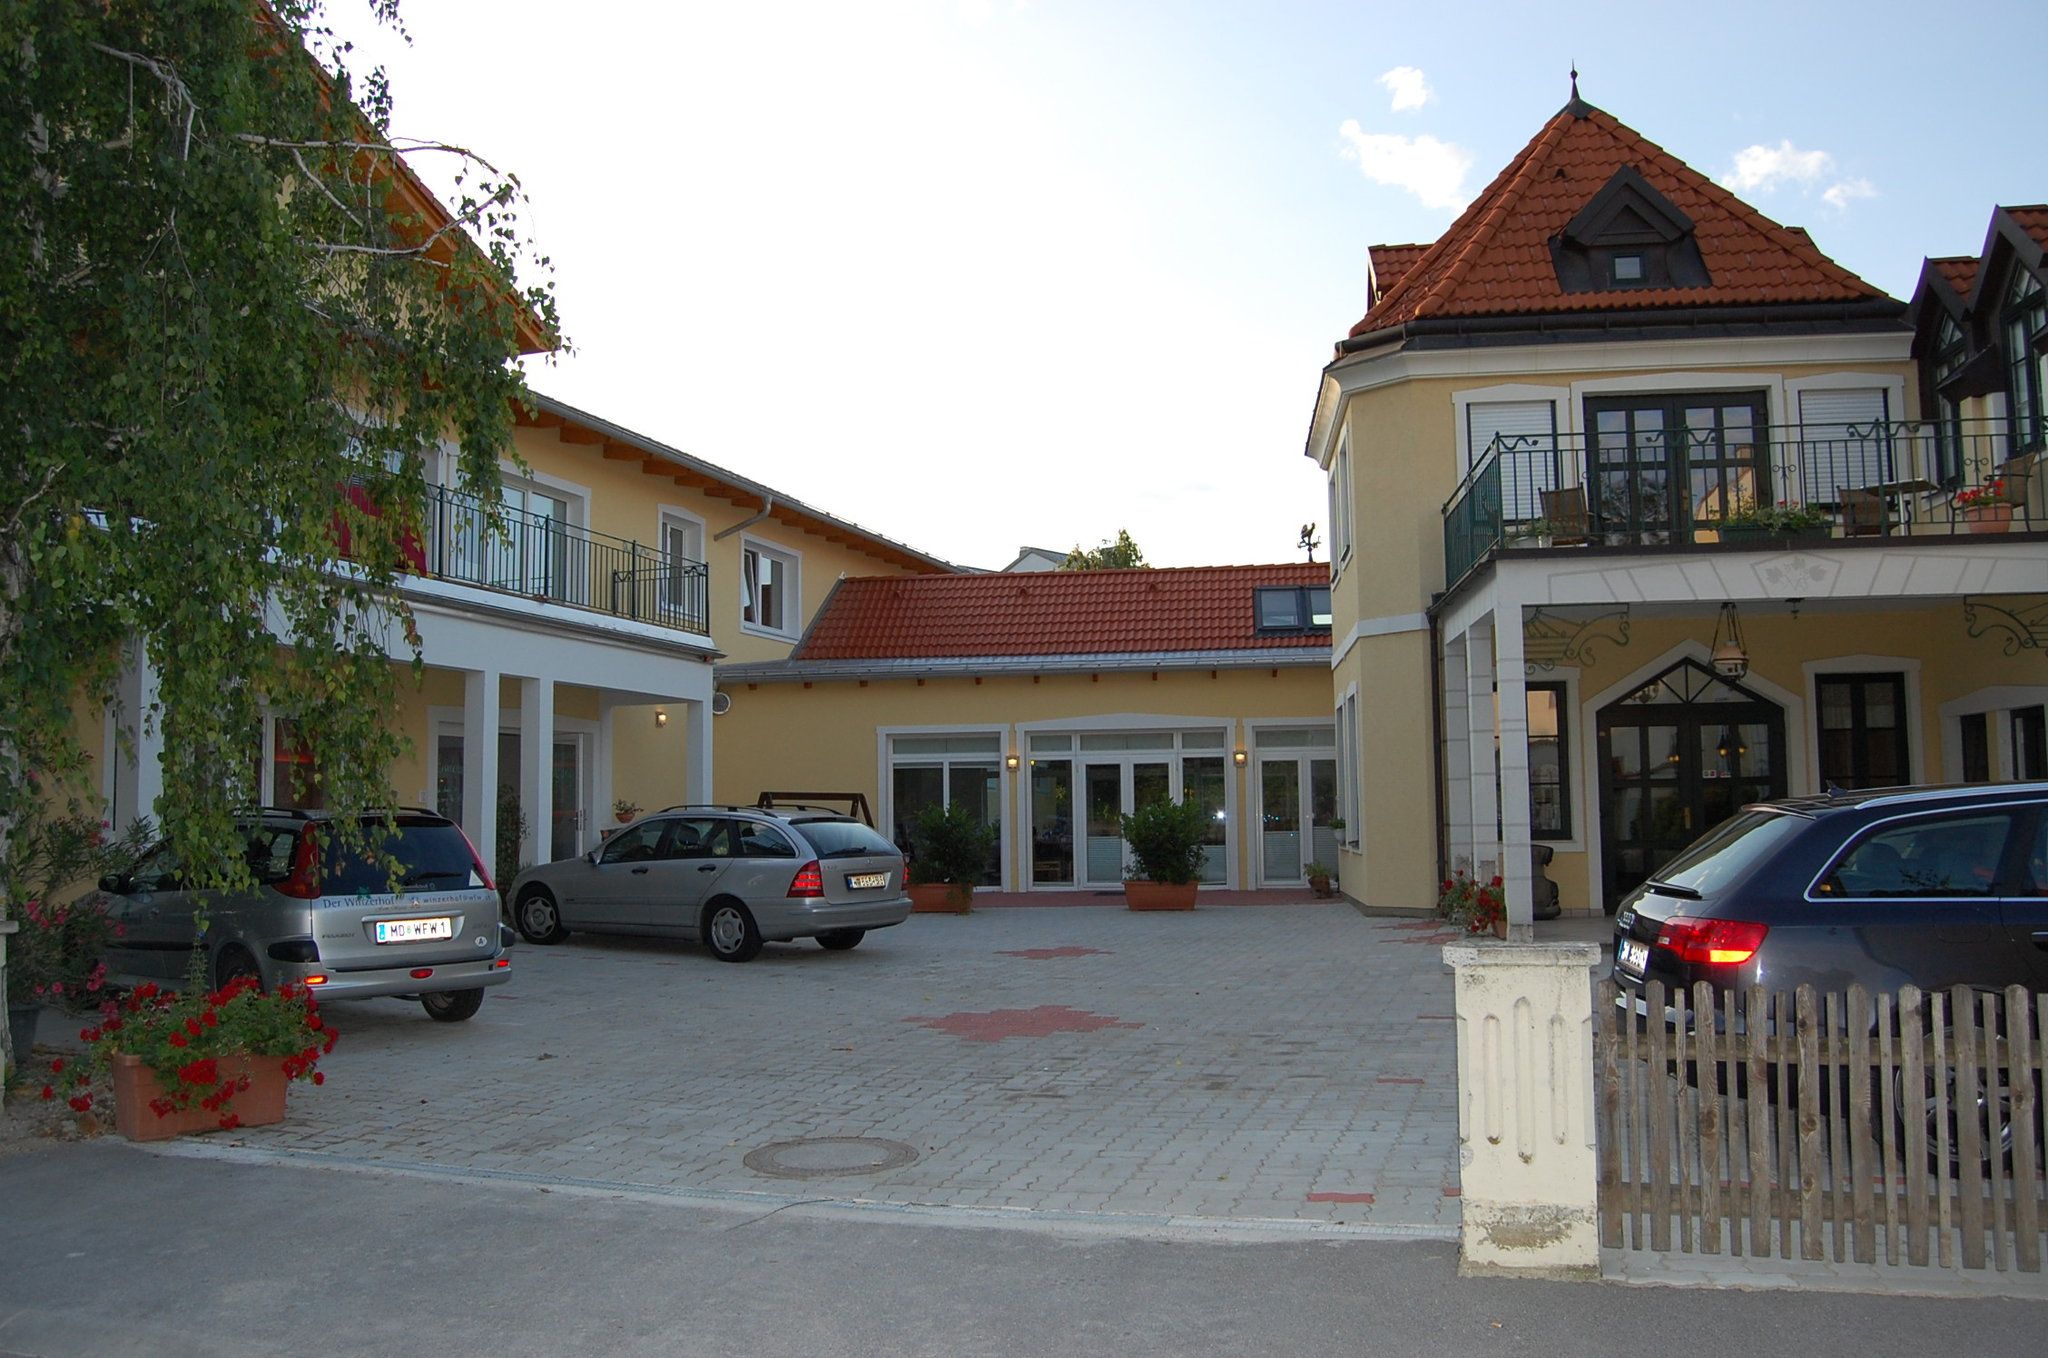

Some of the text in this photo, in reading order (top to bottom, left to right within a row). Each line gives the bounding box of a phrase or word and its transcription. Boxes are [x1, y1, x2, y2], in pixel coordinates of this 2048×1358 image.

[323, 895, 395, 909] Der Winzerhof
[391, 925, 405, 937] MD
[414, 923, 438, 935] WFW
